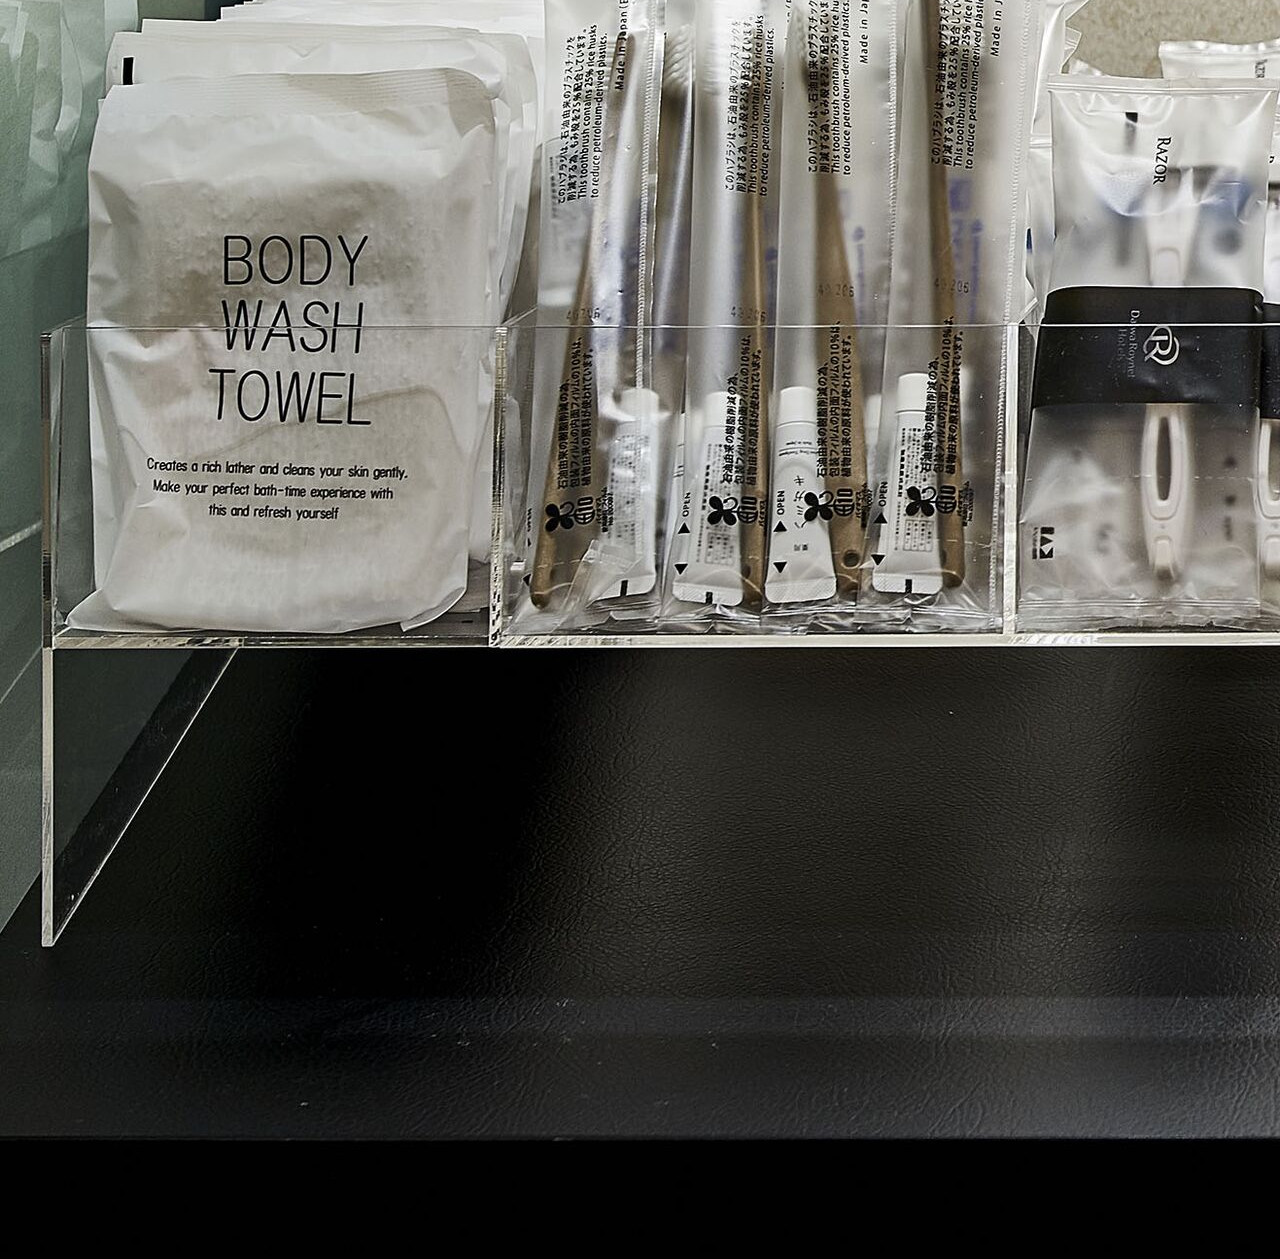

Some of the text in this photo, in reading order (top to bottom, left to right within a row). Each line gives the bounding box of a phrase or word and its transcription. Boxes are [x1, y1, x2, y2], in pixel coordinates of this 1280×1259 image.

[618, 11, 628, 41] Japan
[831, 15, 839, 32] rice
[859, 19, 868, 29] in
[964, 5, 972, 23] rice
[993, 10, 1002, 21] in
[831, 35, 839, 55] 25%
[859, 34, 868, 63] Made
[962, 26, 971, 45] 25%
[990, 26, 1001, 56] Made
[618, 46, 626, 56] in
[615, 61, 626, 89] Made
[831, 57, 840, 96] contains
[841, 0, 851, 163] reduce plastics.
[958, 49, 969, 89] contains
[578, 25, 597, 199] This toothbrush contains 25% rice husks
[591, 33, 608, 186] reduce plastics.
[748, 15, 764, 193] This toothbrush contains 25% rice husks
[760, 28, 774, 184] reduce plastics.
[955, 92, 966, 145] toothbrush
[831, 99, 840, 152] toothbrush
[966, 124, 976, 157] reduce
[831, 155, 840, 173] This
[953, 148, 963, 167] This
[1153, 137, 1171, 184] RAZOR
[224, 235, 368, 286] BODY
[221, 299, 363, 353] WASH
[1128, 343, 1138, 378] Roynet
[209, 369, 371, 425] TOWEL
[147, 458, 408, 480] Creates a rich lather and cleans your skin gently.
[153, 480, 393, 500] Make your perfect bath-time experience with
[683, 492, 691, 517] OPEN
[777, 491, 785, 515] OPEN
[878, 482, 888, 507] OPEN
[209, 504, 339, 521] this and refresh yourself
